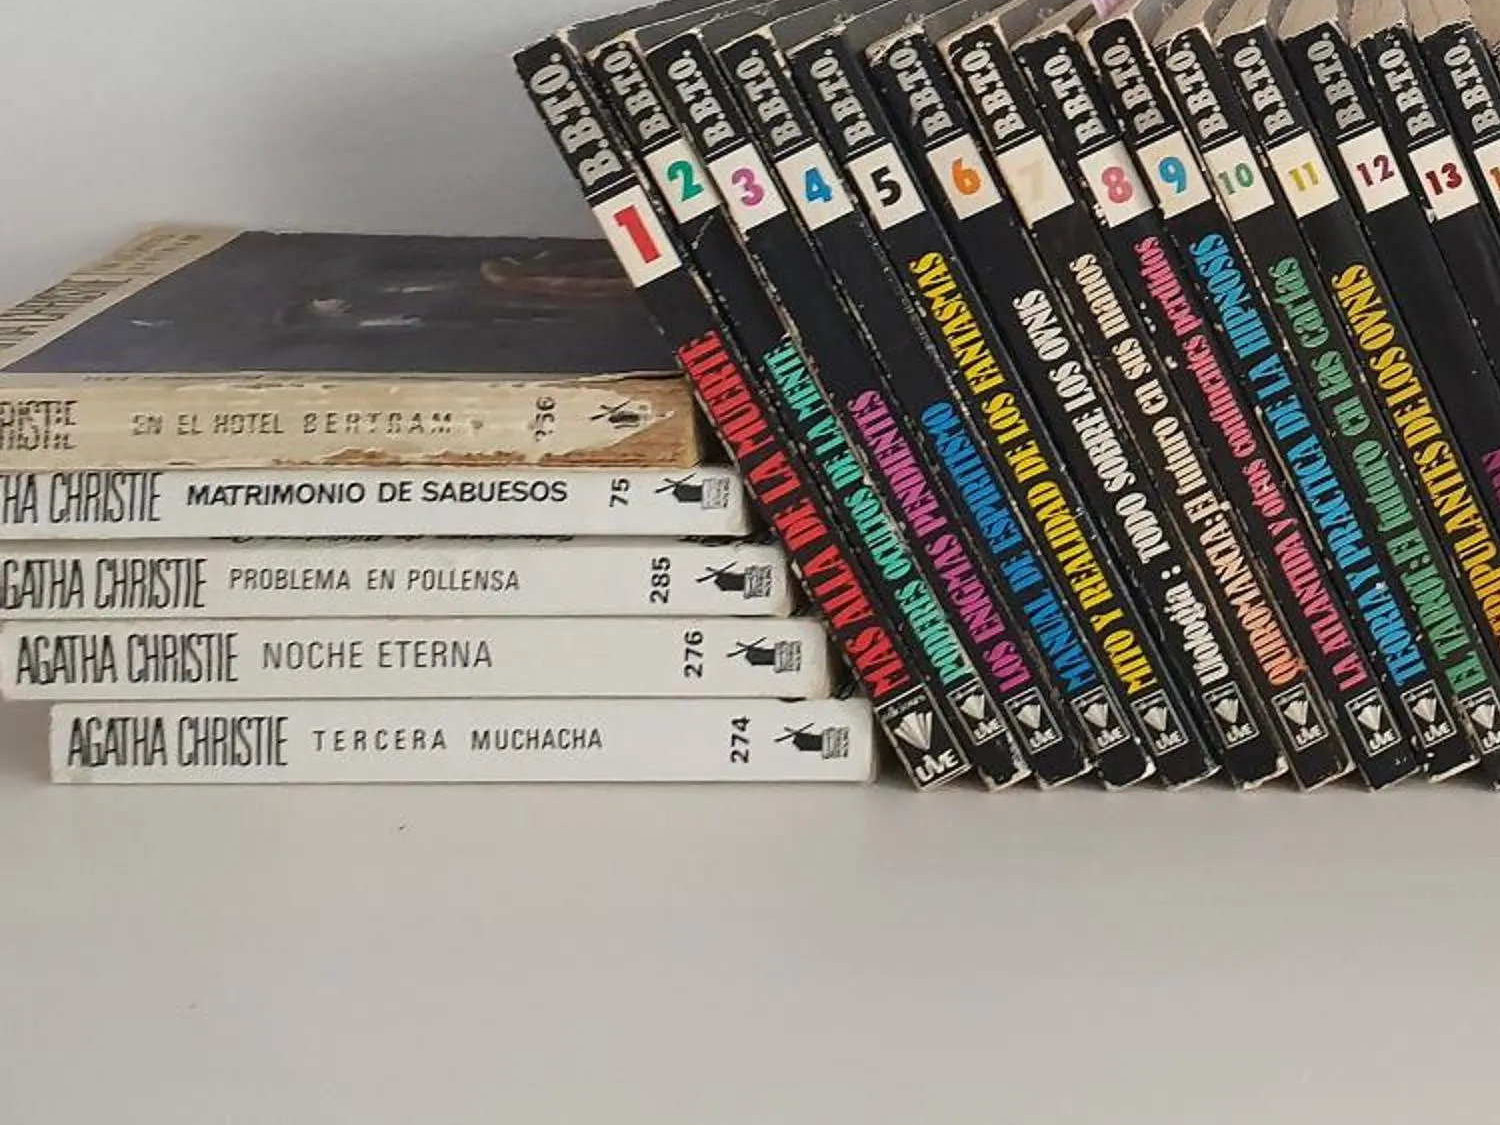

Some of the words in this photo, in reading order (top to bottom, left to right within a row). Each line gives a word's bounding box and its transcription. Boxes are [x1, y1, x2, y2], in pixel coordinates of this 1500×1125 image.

[736, 49, 802, 147] B.B.T.O.
[882, 39, 953, 137] B.B.T.O.
[1044, 47, 1106, 144] B.B.T.O.
[1307, 32, 1366, 129] B.B.T.O.
[530, 53, 623, 187] B.B.T.O.
[667, 160, 704, 202] 2
[731, 168, 764, 206] 3
[805, 167, 832, 203] 4
[870, 166, 902, 207] 5
[952, 158, 981, 195] 6
[1101, 166, 1133, 204] 8
[1158, 156, 1186, 194] 9
[1218, 163, 1254, 195] 10
[1289, 162, 1319, 191] 11
[1356, 155, 1395, 187] 12
[1425, 163, 1463, 196] 13
[613, 205, 661, 264] 1
[1135, 237, 1203, 336] perdidos
[1189, 234, 1271, 359] HIPNOSIS
[1331, 265, 1395, 350] OVNIS
[910, 252, 1005, 395] FANTASMAS
[1013, 289, 1070, 361] OVNIS
[679, 331, 774, 458] MUERTE
[763, 341, 827, 421] MENTE
[1049, 361, 1096, 412] LOS
[1183, 335, 1256, 457] continentes
[1248, 353, 1292, 399] LA
[1370, 347, 1422, 407] LOS
[176, 413, 203, 436] EL
[212, 412, 285, 435] HOTEL
[806, 415, 848, 455] LA
[982, 393, 1029, 444] LOS
[1265, 395, 1310, 440] DE
[1393, 397, 1442, 448] DE
[823, 448, 867, 489] DE
[848, 391, 947, 537] PENDIENTES
[1005, 440, 1049, 483] DE
[1072, 407, 1136, 492] SOBRE
[50, 472, 164, 523] CHRISTIE
[187, 482, 366, 506] MATRIMONIO
[377, 481, 413, 503] DE
[421, 480, 569, 504] SABUESOS
[609, 478, 631, 508] 75
[749, 451, 800, 504] LA
[921, 403, 1023, 554] ESPIRITISMO
[1242, 459, 1285, 517] otros
[1287, 434, 1371, 569] PRACTICA
[774, 498, 826, 550] DE
[844, 481, 919, 580] OCULTOS
[1027, 481, 1113, 610] REALIDAD
[1116, 493, 1171, 564] TODO
[1267, 518, 1298, 536] y
[95, 558, 208, 610] CHRISTIE
[228, 568, 351, 591] PROBLEMA
[366, 568, 396, 591] EN
[407, 568, 521, 592] POLLENSA
[649, 556, 671, 605] 285
[803, 545, 873, 628] ALLA
[926, 534, 1005, 643] ENIGMAS
[1000, 550, 1043, 592] DE
[1274, 531, 1351, 654] ATLANTIDA
[1345, 564, 1380, 591] Y
[895, 580, 975, 685] PODERES
[1024, 588, 1096, 691] MANUAL
[1090, 608, 1123, 632] Y
[1358, 581, 1426, 686] TEORIA
[16, 634, 118, 686] AGATHA
[127, 632, 240, 684] CHRISTIE
[262, 639, 364, 671] NOCHE
[376, 639, 493, 669] ETERNA
[683, 630, 704, 679] 276
[846, 627, 908, 697] MAS
[983, 641, 1030, 691] LOS
[1103, 630, 1157, 694] MITO
[1332, 652, 1367, 690] LA
[67, 716, 168, 768] AGATHA
[177, 716, 289, 768] CHRISTIE
[312, 728, 447, 752] TERCERA
[470, 726, 603, 751] MUCHACHA
[730, 715, 752, 764] 274
